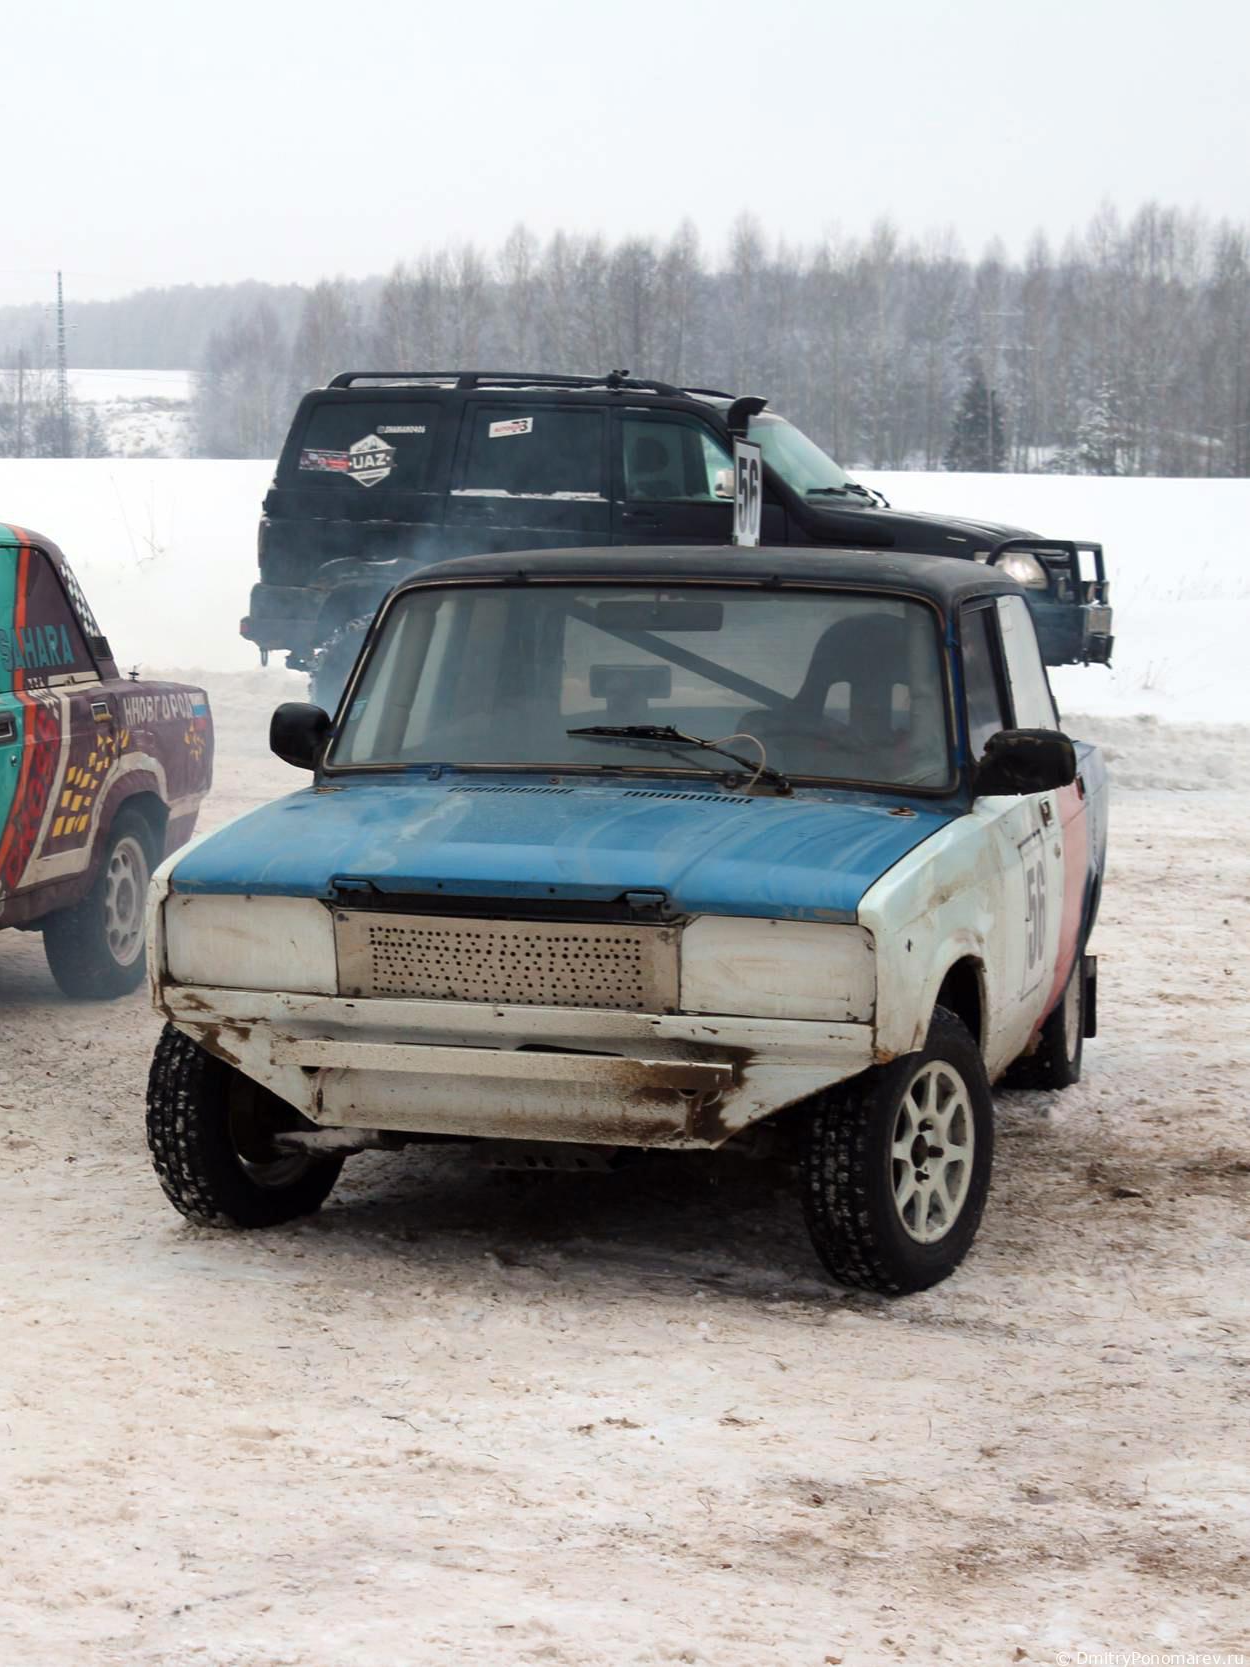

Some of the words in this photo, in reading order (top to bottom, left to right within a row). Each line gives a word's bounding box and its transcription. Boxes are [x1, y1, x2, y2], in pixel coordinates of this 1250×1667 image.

[352, 453, 387, 470] UAZ
[738, 456, 759, 536] 56
[1026, 860, 1047, 970] 56
